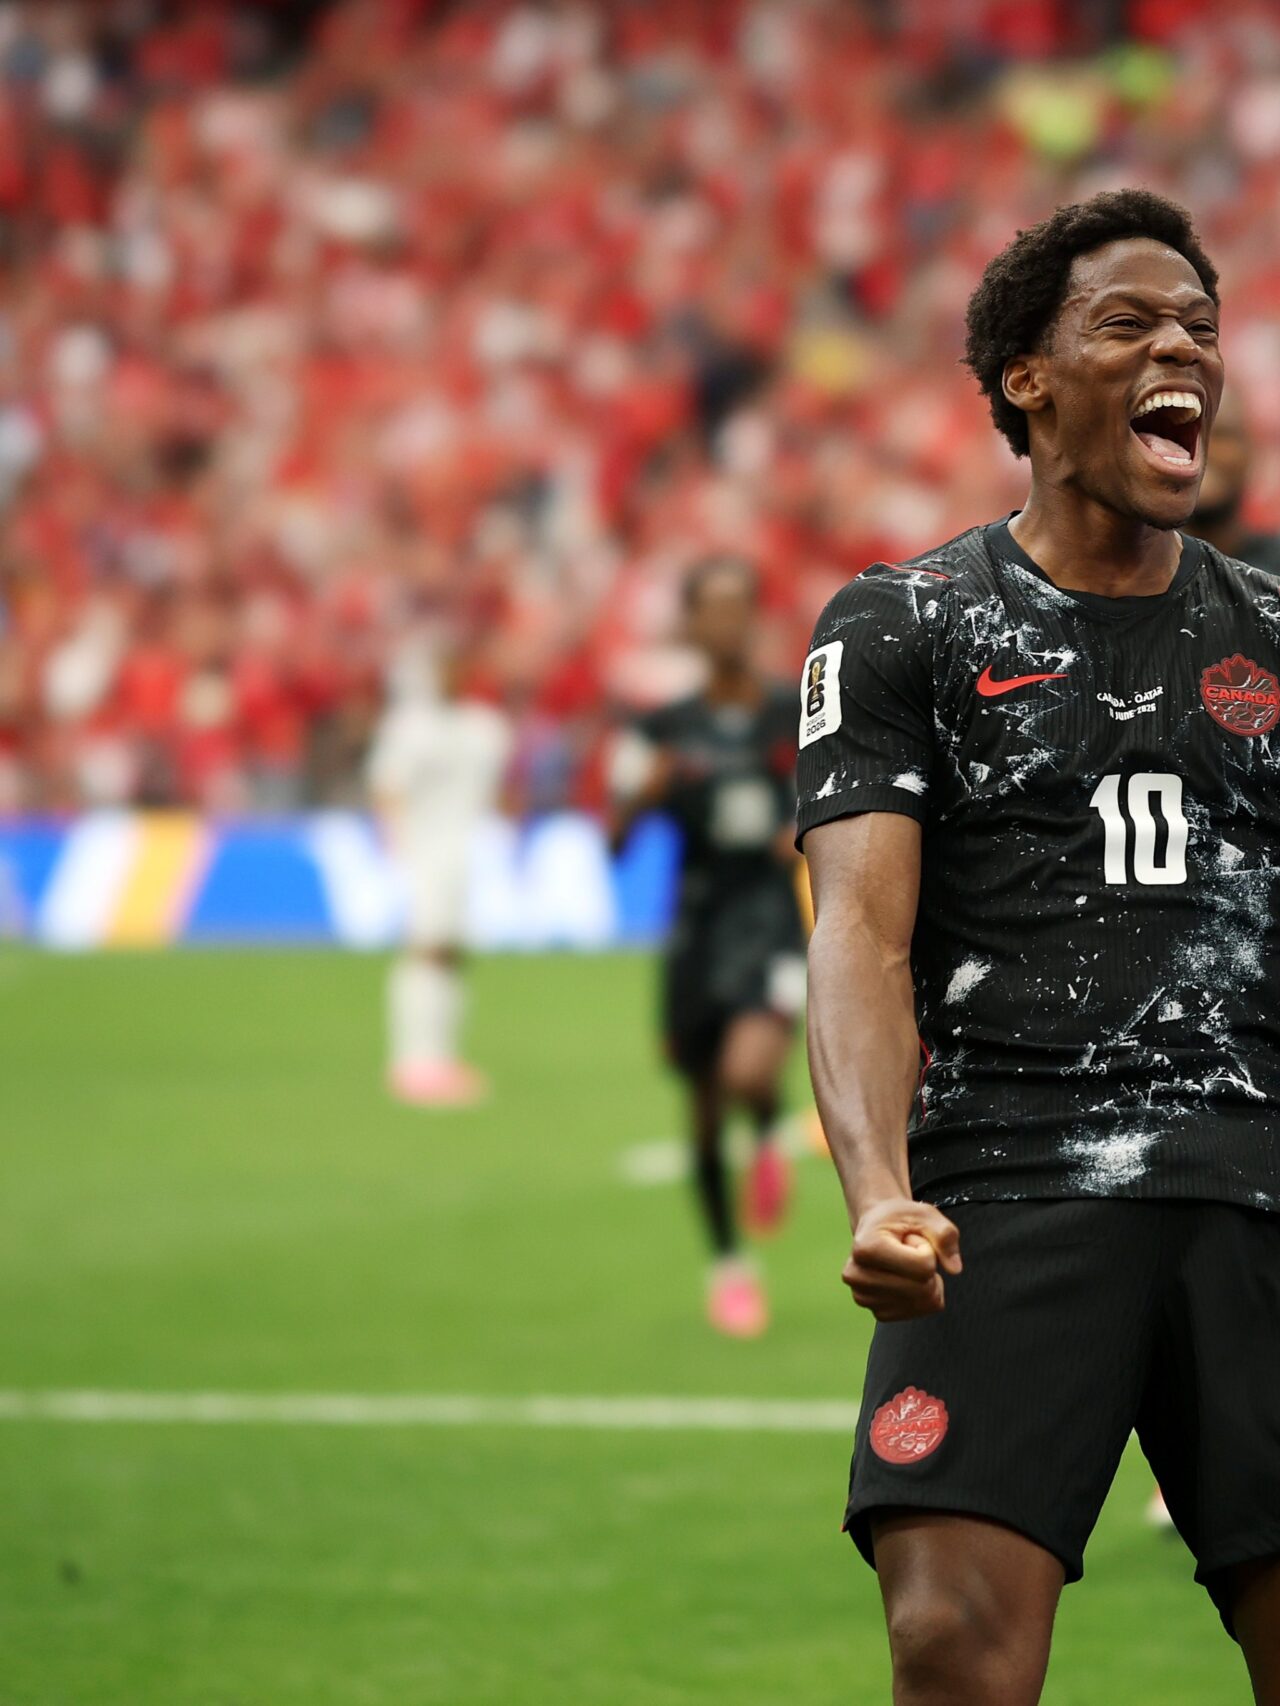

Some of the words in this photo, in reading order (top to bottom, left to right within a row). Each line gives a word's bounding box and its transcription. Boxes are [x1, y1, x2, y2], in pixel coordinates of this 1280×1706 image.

[1205, 686, 1279, 706] CANADA
[1115, 709, 1135, 721] JUNE
[806, 719, 826, 737] 2026
[1088, 772, 1189, 885] 10
